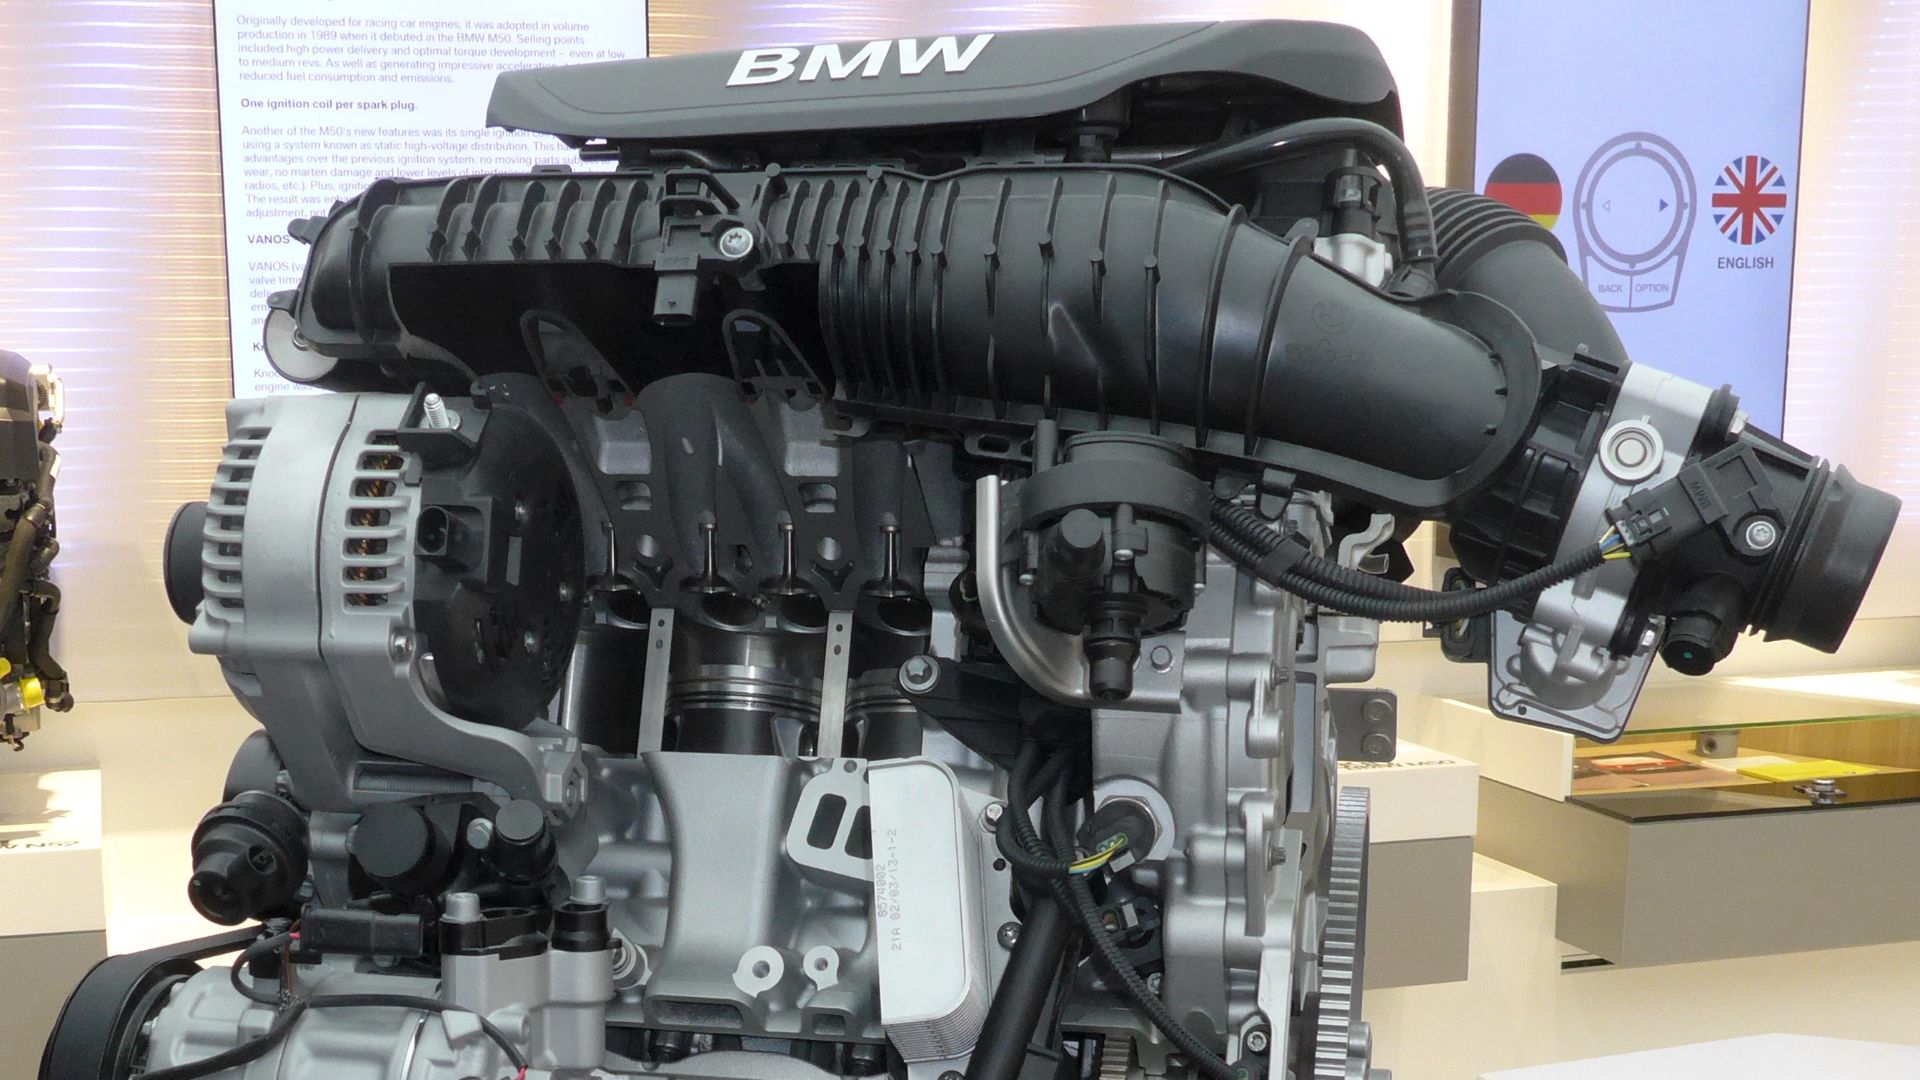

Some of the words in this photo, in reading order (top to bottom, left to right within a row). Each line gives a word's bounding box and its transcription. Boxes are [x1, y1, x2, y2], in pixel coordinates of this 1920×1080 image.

[236, 15, 287, 28] Originally
[290, 17, 346, 28] developed
[349, 18, 361, 26] for
[365, 18, 398, 30] racing
[465, 20, 472, 29] it
[496, 20, 538, 32] adopted
[542, 22, 550, 30] in
[552, 22, 590, 31] volume
[237, 30, 294, 42] production
[298, 31, 306, 39] in
[312, 30, 337, 40] 1989
[340, 31, 368, 40] when
[371, 32, 377, 41] it
[380, 32, 423, 42] debuted
[426, 33, 434, 42] in
[438, 33, 454, 42] the
[457, 34, 485, 43] BMW
[516, 34, 551, 46] Selling
[554, 36, 585, 46] points
[238, 44, 284, 53] included
[286, 44, 309, 56] high
[312, 46, 346, 56] power
[347, 45, 388, 57] delivery
[391, 46, 410, 55] and
[413, 46, 451, 58] optimal
[454, 48, 487, 58] torque
[490, 48, 556, 60] development
[596, 50, 605, 58] at
[608, 49, 625, 58] low
[239, 58, 249, 66] to
[252, 58, 295, 67] medium
[326, 58, 339, 68] As
[342, 58, 363, 68] well
[380, 60, 436, 71] generating
[438, 61, 493, 72] impressive
[726, 34, 995, 87] BMW
[240, 72, 283, 81] reduced
[286, 72, 305, 81] fuel
[308, 72, 376, 84] consumption
[378, 73, 397, 82] and
[241, 98, 264, 108] One
[267, 99, 310, 110] ignition
[312, 100, 332, 108] coil
[336, 101, 353, 111] per
[357, 100, 388, 111] spark
[242, 126, 284, 136] Another
[286, 126, 298, 136] of
[300, 126, 316, 136] the
[378, 127, 420, 137] features
[445, 128, 457, 137] its
[460, 128, 490, 140] single
[243, 141, 271, 151] using
[283, 141, 320, 152] system
[324, 140, 356, 150] known
[374, 141, 400, 150] static
[404, 141, 467, 152] high-voltage
[533, 142, 554, 150] This
[244, 154, 303, 165] advantages
[332, 154, 348, 163] the
[351, 155, 394, 165] previous
[398, 154, 435, 166] ignition
[495, 155, 532, 166] moving
[535, 156, 560, 166] parts
[291, 168, 327, 176] marten
[330, 168, 372, 179] damage
[375, 168, 394, 177] and
[397, 168, 424, 177] lower
[428, 168, 456, 176] levels
[459, 168, 469, 176] of
[246, 194, 265, 204] The
[269, 194, 298, 204] result
[248, 235, 290, 244] VANOS
[249, 262, 289, 271] VANOS
[1717, 257, 1774, 270] ENGLISH
[250, 276, 276, 285] valve
[1598, 284, 1622, 293] BACK
[1635, 284, 1669, 293] OPTION
[255, 382, 290, 393] engine
[891, 927, 902, 952] 21A
